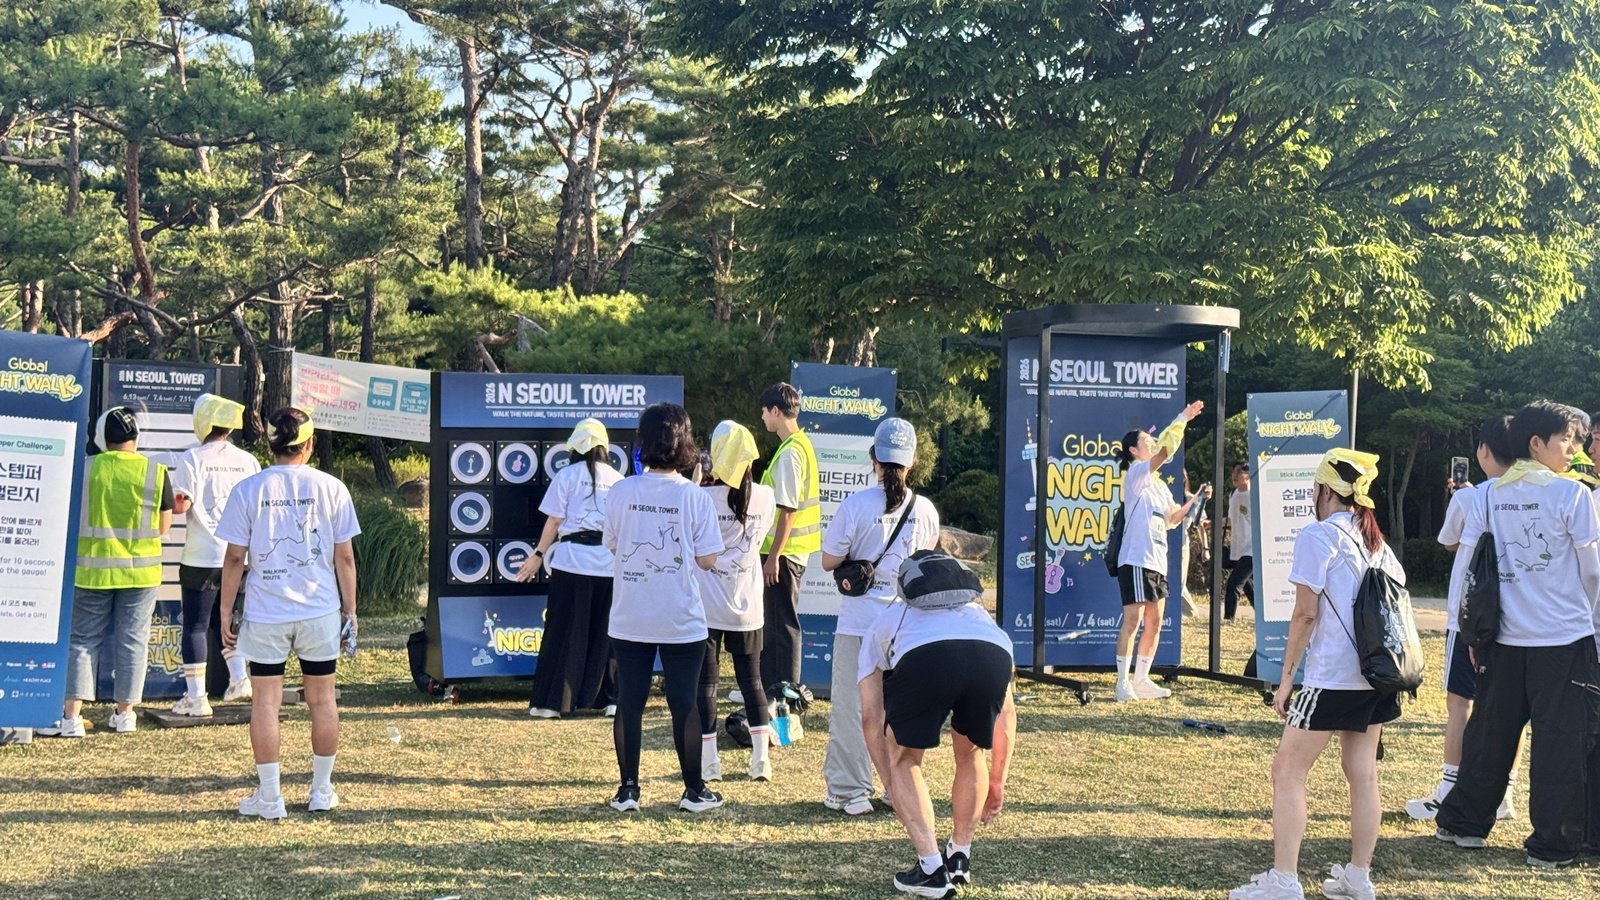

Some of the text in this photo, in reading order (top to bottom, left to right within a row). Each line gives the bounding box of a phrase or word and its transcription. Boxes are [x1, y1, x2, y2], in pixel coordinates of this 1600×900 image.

[9, 356, 48, 373] Global
[135, 371, 169, 383] SEOUL
[169, 372, 205, 385] TOWER
[1020, 359, 1030, 381] 2026
[1050, 359, 1111, 383] SEOUL
[1113, 361, 1179, 386] TOWER
[25, 373, 83, 401] WALK
[485, 382, 647, 406] 2026 N SEOUL TOWER
[830, 386, 860, 397] Global
[802, 397, 888, 420] NIGHT WALK
[1285, 410, 1313, 420] Global
[1260, 418, 1341, 439] NIGHT WALK
[16, 440, 54, 451] Challenge
[293, 498, 315, 506] TOWER
[638, 505, 658, 513] SEOUL
[1500, 503, 1520, 511] SEOUL
[2, 516, 42, 526] 안에 빠르게
[1047, 506, 1117, 546] WAL
[14, 557, 22, 565] 10
[24, 558, 55, 567] seconds
[1015, 613, 1034, 627] 6.1
[1076, 613, 1096, 627] 7.4
